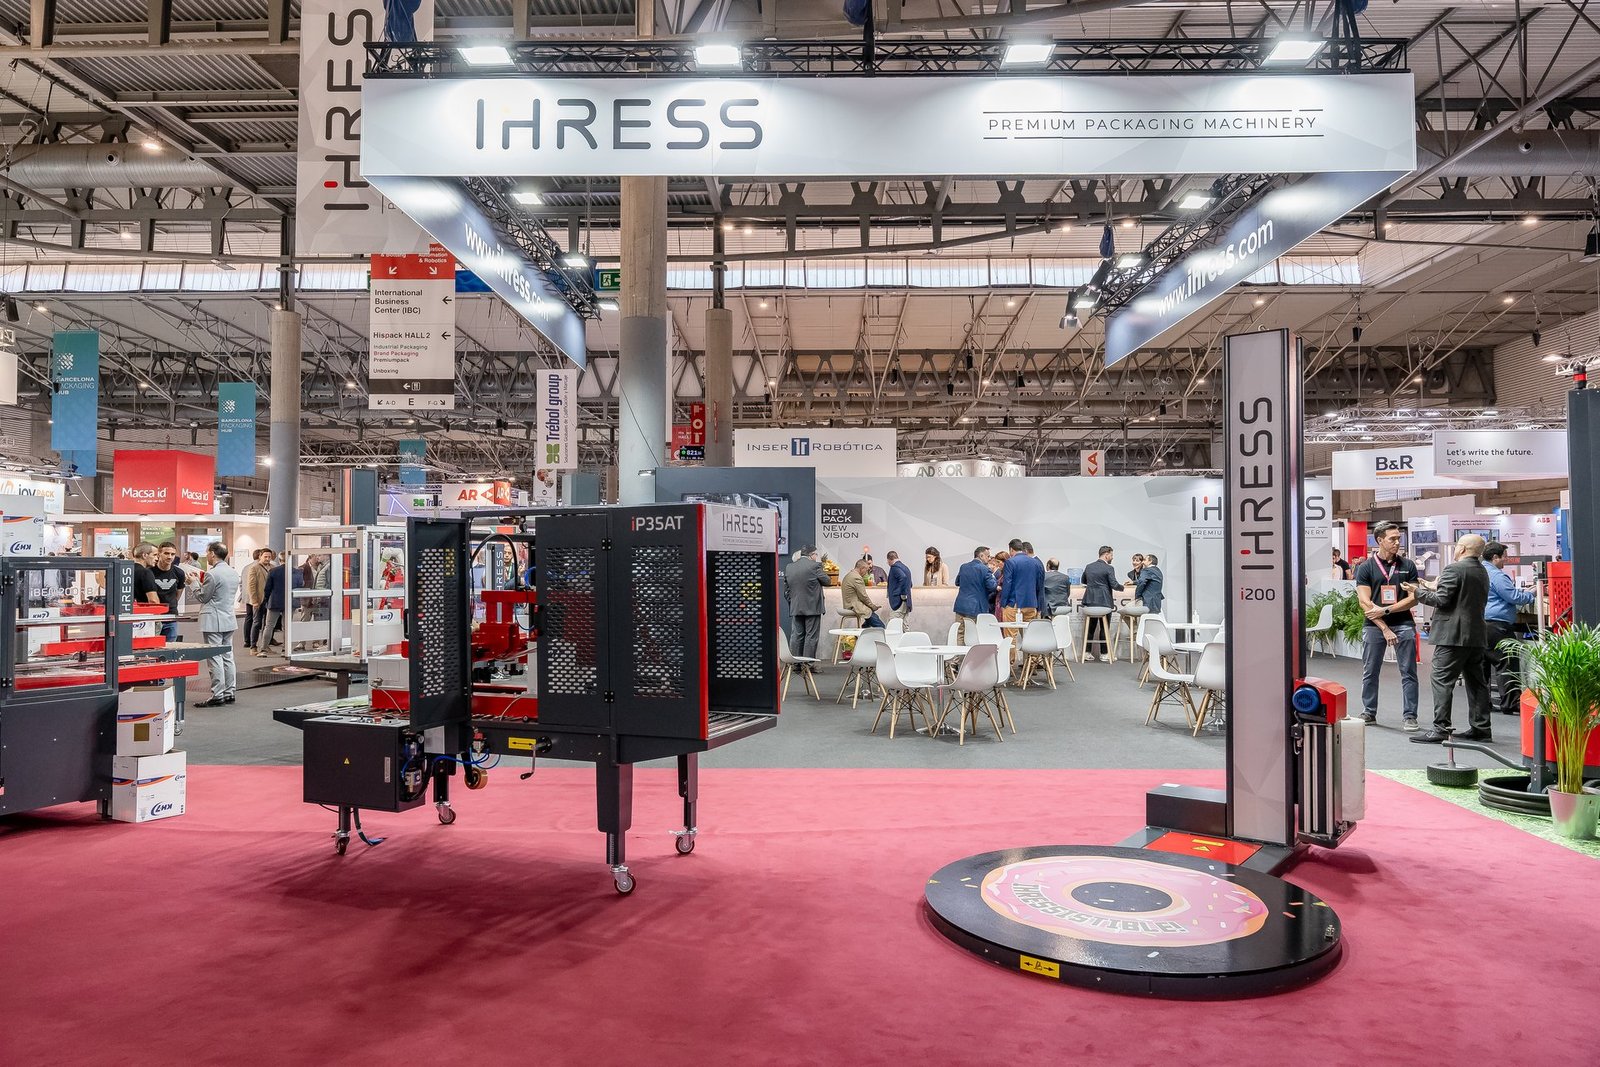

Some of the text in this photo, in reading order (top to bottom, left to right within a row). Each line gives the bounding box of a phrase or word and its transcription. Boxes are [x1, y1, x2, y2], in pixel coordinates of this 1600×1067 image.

[324, 8, 373, 210] IHRES
[476, 98, 763, 150] IHRESS
[988, 116, 1317, 131] PREMIUM PACKAGING MACHINERY
[373, 332, 403, 340] Hispack
[545, 374, 562, 442] Trébol group
[747, 442, 788, 451] INSER
[812, 442, 884, 451] ROBÓTICA
[1376, 455, 1413, 470] B&R
[1447, 458, 1482, 467] Together
[1239, 397, 1274, 570] IHRESS
[122, 487, 167, 498] Macsa id
[182, 488, 202, 500] Macsa
[632, 516, 684, 531] iP35AT
[722, 513, 763, 534] IHRESS
[122, 567, 132, 611] HRESS
[1241, 588, 1276, 600] i200
